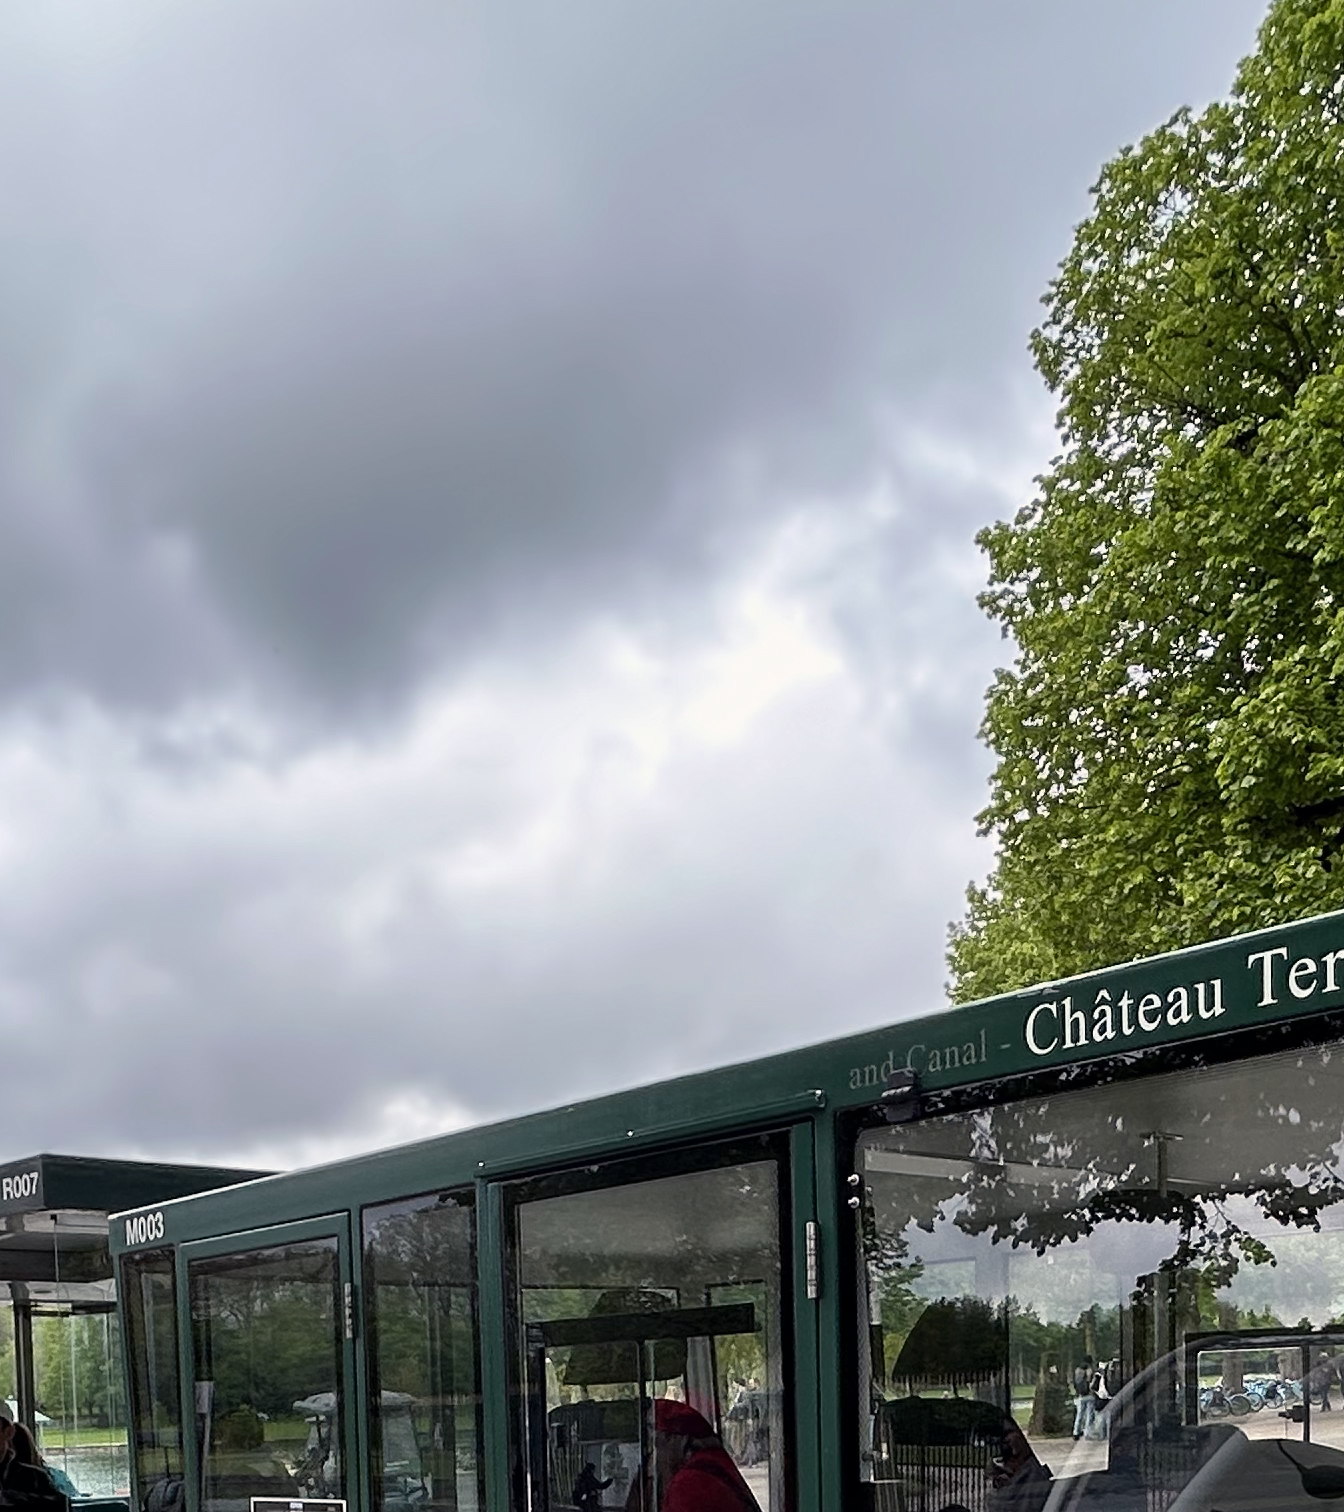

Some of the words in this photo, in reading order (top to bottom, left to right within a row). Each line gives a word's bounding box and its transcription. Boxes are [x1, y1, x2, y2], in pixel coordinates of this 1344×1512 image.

[906, 1027, 987, 1078] Canal
[1024, 976, 1226, 1057] Château
[2, 1171, 39, 1201] R007
[125, 1211, 165, 1246] M003
